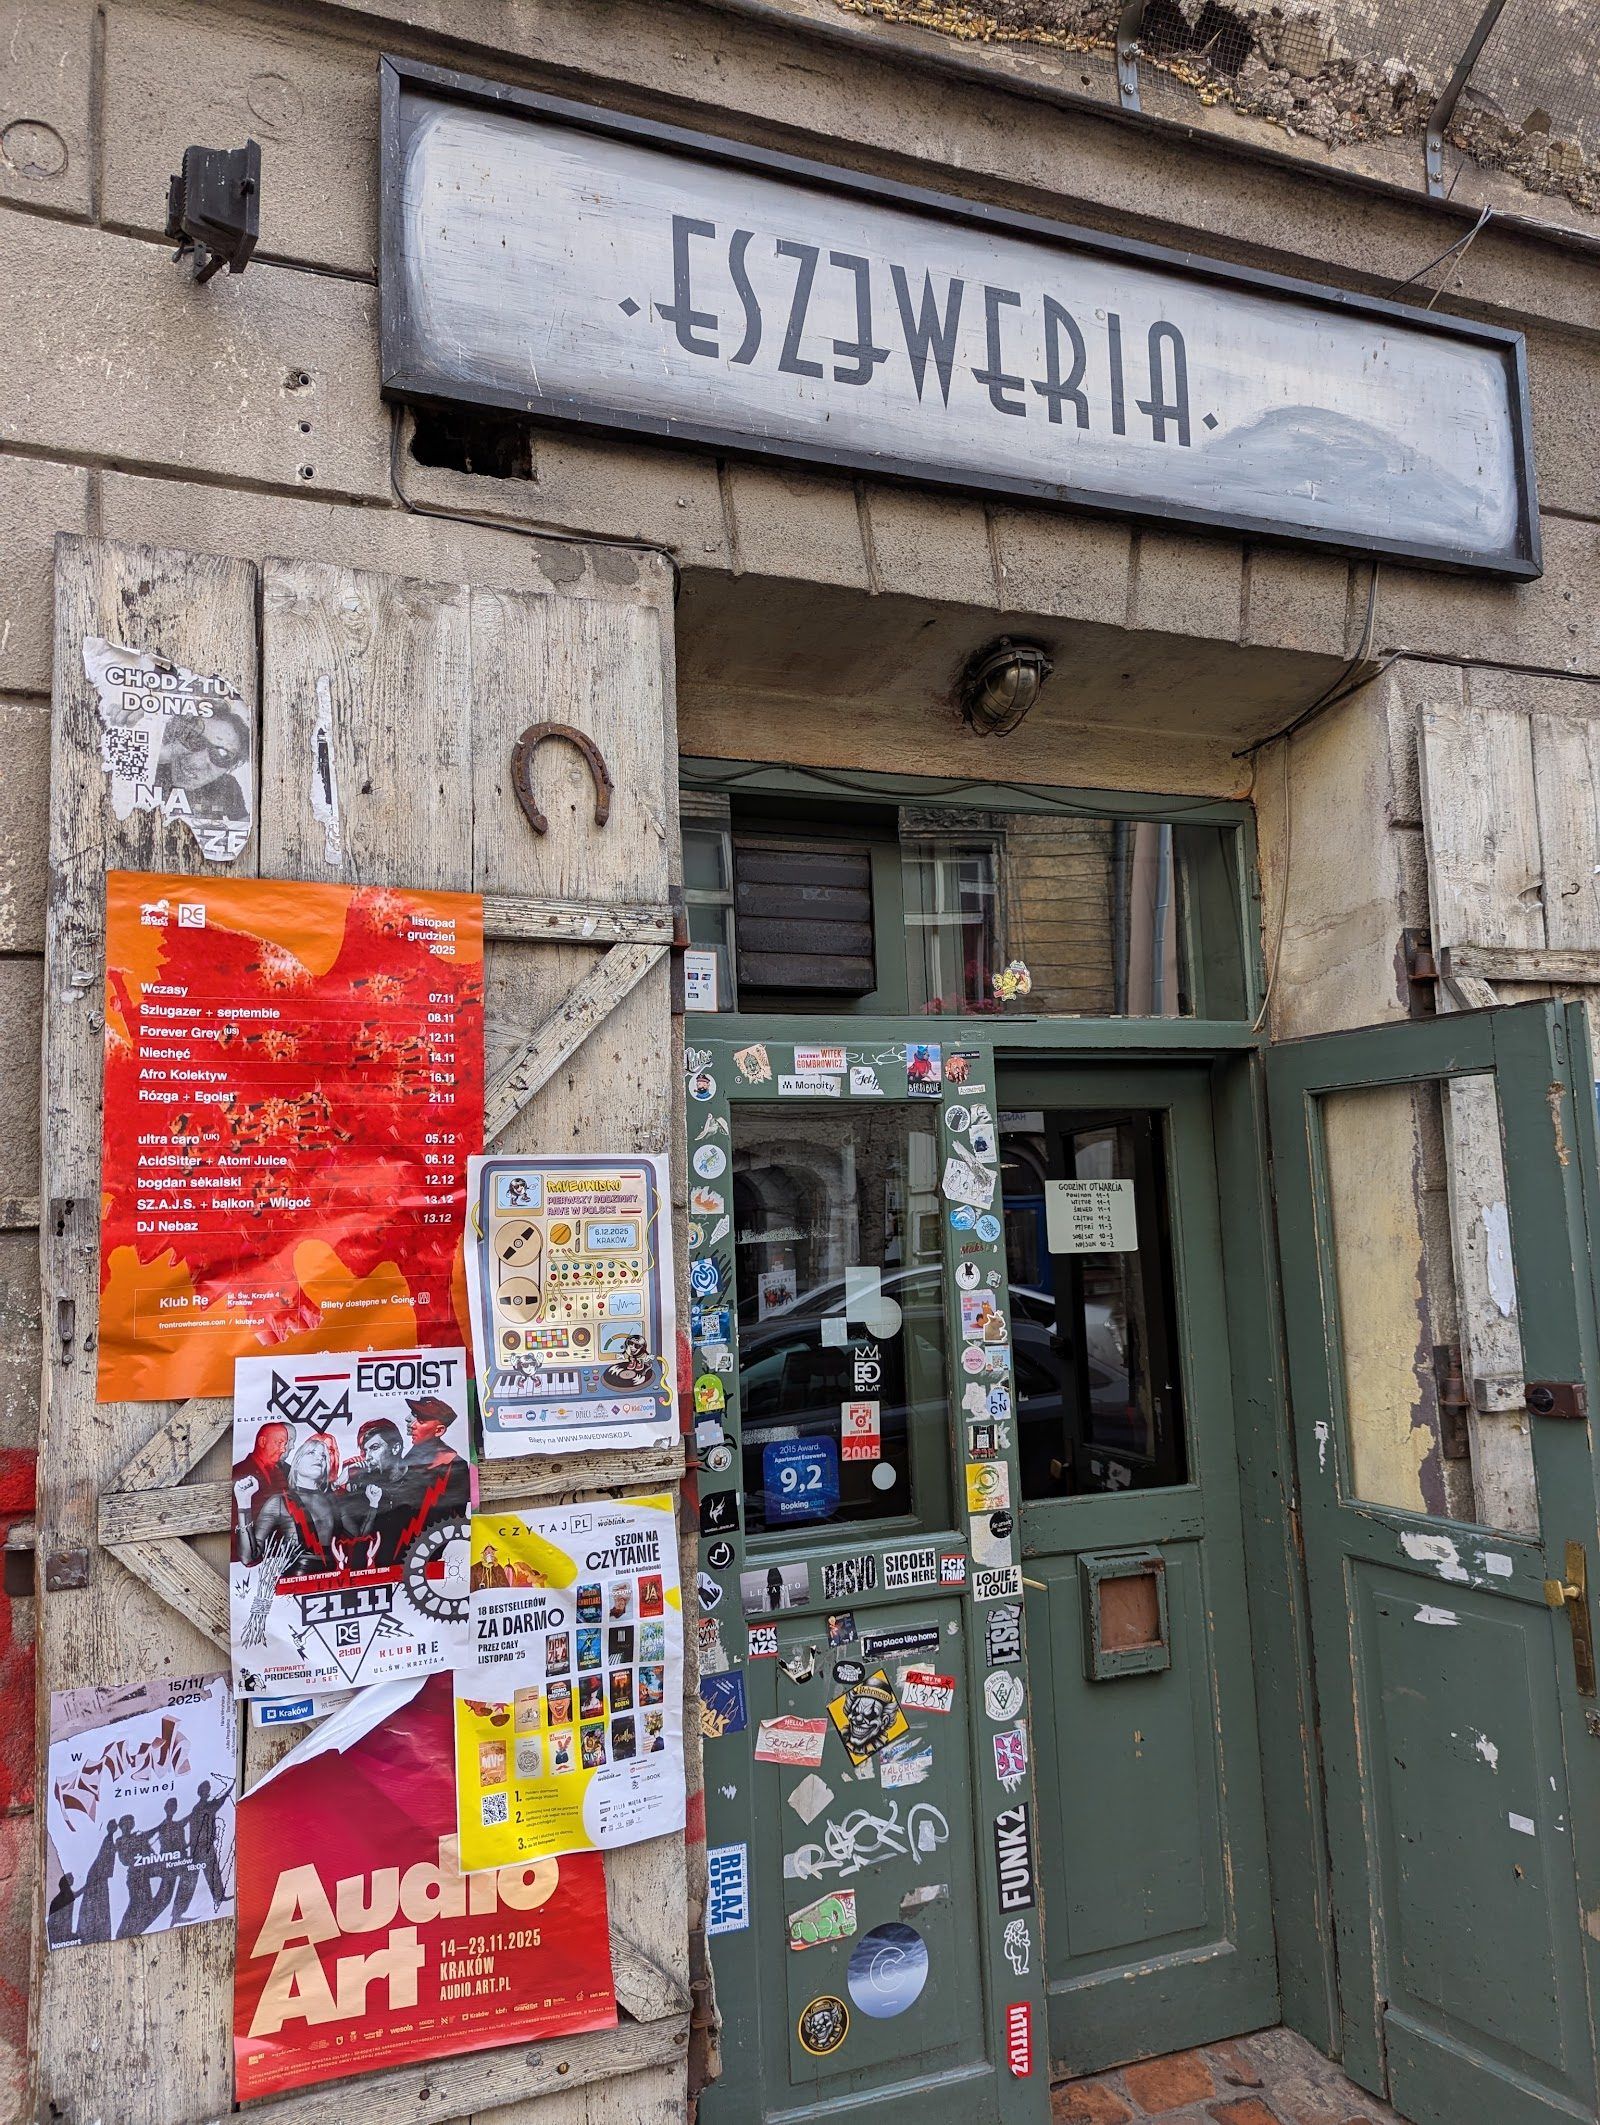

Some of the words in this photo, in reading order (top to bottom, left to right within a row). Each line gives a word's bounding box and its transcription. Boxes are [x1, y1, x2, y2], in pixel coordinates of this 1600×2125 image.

[122, 692, 161, 713] DO
[163, 696, 214, 718] NAS
[411, 916, 456, 929] listopad
[407, 930, 456, 942] grudzień
[429, 944, 456, 955] 2025
[140, 983, 188, 997] Wczasy
[428, 992, 455, 1004] 07.11
[140, 1004, 202, 1018] Szlugazer
[427, 1012, 455, 1024] 08.11
[140, 1026, 187, 1037] Forever
[190, 1028, 220, 1041] Grey
[428, 1032, 455, 1044] 12.11
[139, 1046, 191, 1060] Niechęć
[428, 1052, 455, 1063] 14.11
[820, 1049, 842, 1058] WITEK
[139, 1068, 166, 1080] Afro
[170, 1069, 228, 1083] Kolektyw
[428, 1071, 455, 1083] 16.11
[138, 1089, 179, 1103] Rózga
[194, 1091, 234, 1104] Egoist
[428, 1092, 455, 1103] 21.11
[138, 1134, 167, 1145] ultra
[171, 1137, 199, 1145] caro
[424, 1134, 455, 1144] 05.12
[137, 1155, 202, 1166] AcidSitter
[217, 1155, 250, 1166] Atom
[254, 1154, 287, 1166] Juice
[424, 1154, 455, 1165] 06.12
[137, 1177, 186, 1191] bogdan
[424, 1175, 455, 1186] 12.12
[212, 1198, 254, 1209] balkon
[270, 1196, 311, 1210] Wilgoć
[424, 1194, 454, 1205] 13.12
[423, 1213, 452, 1224] 13.12
[136, 1221, 154, 1233] DJ
[158, 1220, 198, 1232] Nebaz
[159, 1297, 188, 1308] Klub
[192, 1294, 208, 1306] Re
[321, 1300, 344, 1310] Bilety
[357, 1359, 458, 1392] EGOIST
[237, 1414, 283, 1423] ELECTRO
[779, 1444, 797, 1454] 2015
[843, 1445, 881, 1459] 2005
[780, 1464, 823, 1493] 9,2
[575, 1519, 588, 1529] PL
[615, 1531, 643, 1546] SEZON
[645, 1529, 659, 1542] NA
[586, 1542, 661, 1571] CZYTANIE
[885, 1550, 935, 1572] SICOER
[940, 1558, 966, 1571] FCK
[886, 1572, 910, 1587] WAS
[911, 1568, 936, 1584] HERE
[940, 1569, 966, 1582] TRMP
[976, 1568, 1011, 1587] LOUIE
[983, 1580, 1018, 1598] LOUIE
[305, 1588, 391, 1622] 21.11
[477, 1606, 487, 1616] 18
[488, 1596, 547, 1615] BESTSELLERÓW
[477, 1619, 498, 1639] ZA
[502, 1608, 565, 1637] DARMO
[748, 1627, 777, 1643] FCK
[379, 1645, 412, 1658] KLUB
[417, 1640, 439, 1656] RE
[478, 1642, 500, 1653] PRZEZ
[500, 1639, 519, 1651] CAŁY
[748, 1641, 778, 1656] NZS
[872, 1640, 882, 1648] no
[338, 1646, 361, 1658] 21:00
[478, 1653, 514, 1664] LISTOPAD
[263, 1664, 306, 1673] AFTERPARTY
[264, 1670, 313, 1682] PROCESOR
[315, 1666, 338, 1677] PLUS
[167, 1693, 201, 1707] 2025
[279, 1704, 308, 1718] Kraków
[784, 1719, 805, 1727] HELLO
[114, 1782, 175, 1799] Żniwnej
[133, 1849, 181, 1867] Żniwna
[165, 1857, 193, 1869] Kraków
[995, 1804, 1031, 1909] FUNK2
[720, 1852, 744, 1924] RELAZ
[51, 1937, 82, 1949] koncert
[440, 1955, 495, 1981] KRAKÓW
[248, 1926, 425, 2038] Art
[439, 1976, 512, 2001] AUDIO.ART.PL
